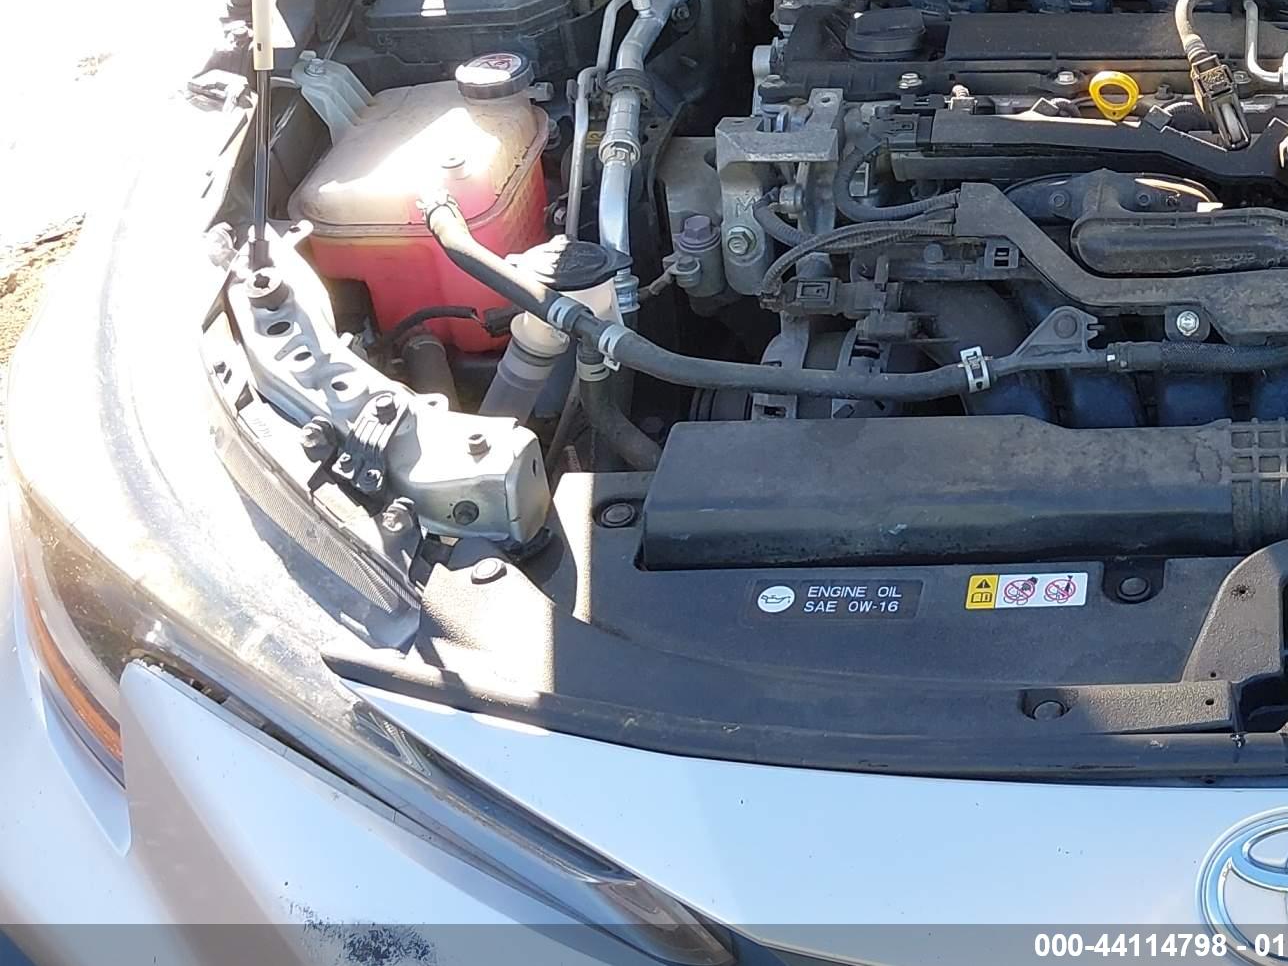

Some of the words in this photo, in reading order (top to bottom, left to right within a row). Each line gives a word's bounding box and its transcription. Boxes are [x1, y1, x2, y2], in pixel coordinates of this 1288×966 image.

[807, 585, 868, 598] ENGINE
[877, 586, 902, 598] OIL
[803, 600, 838, 613] SAE
[848, 600, 899, 613] 0W-16
